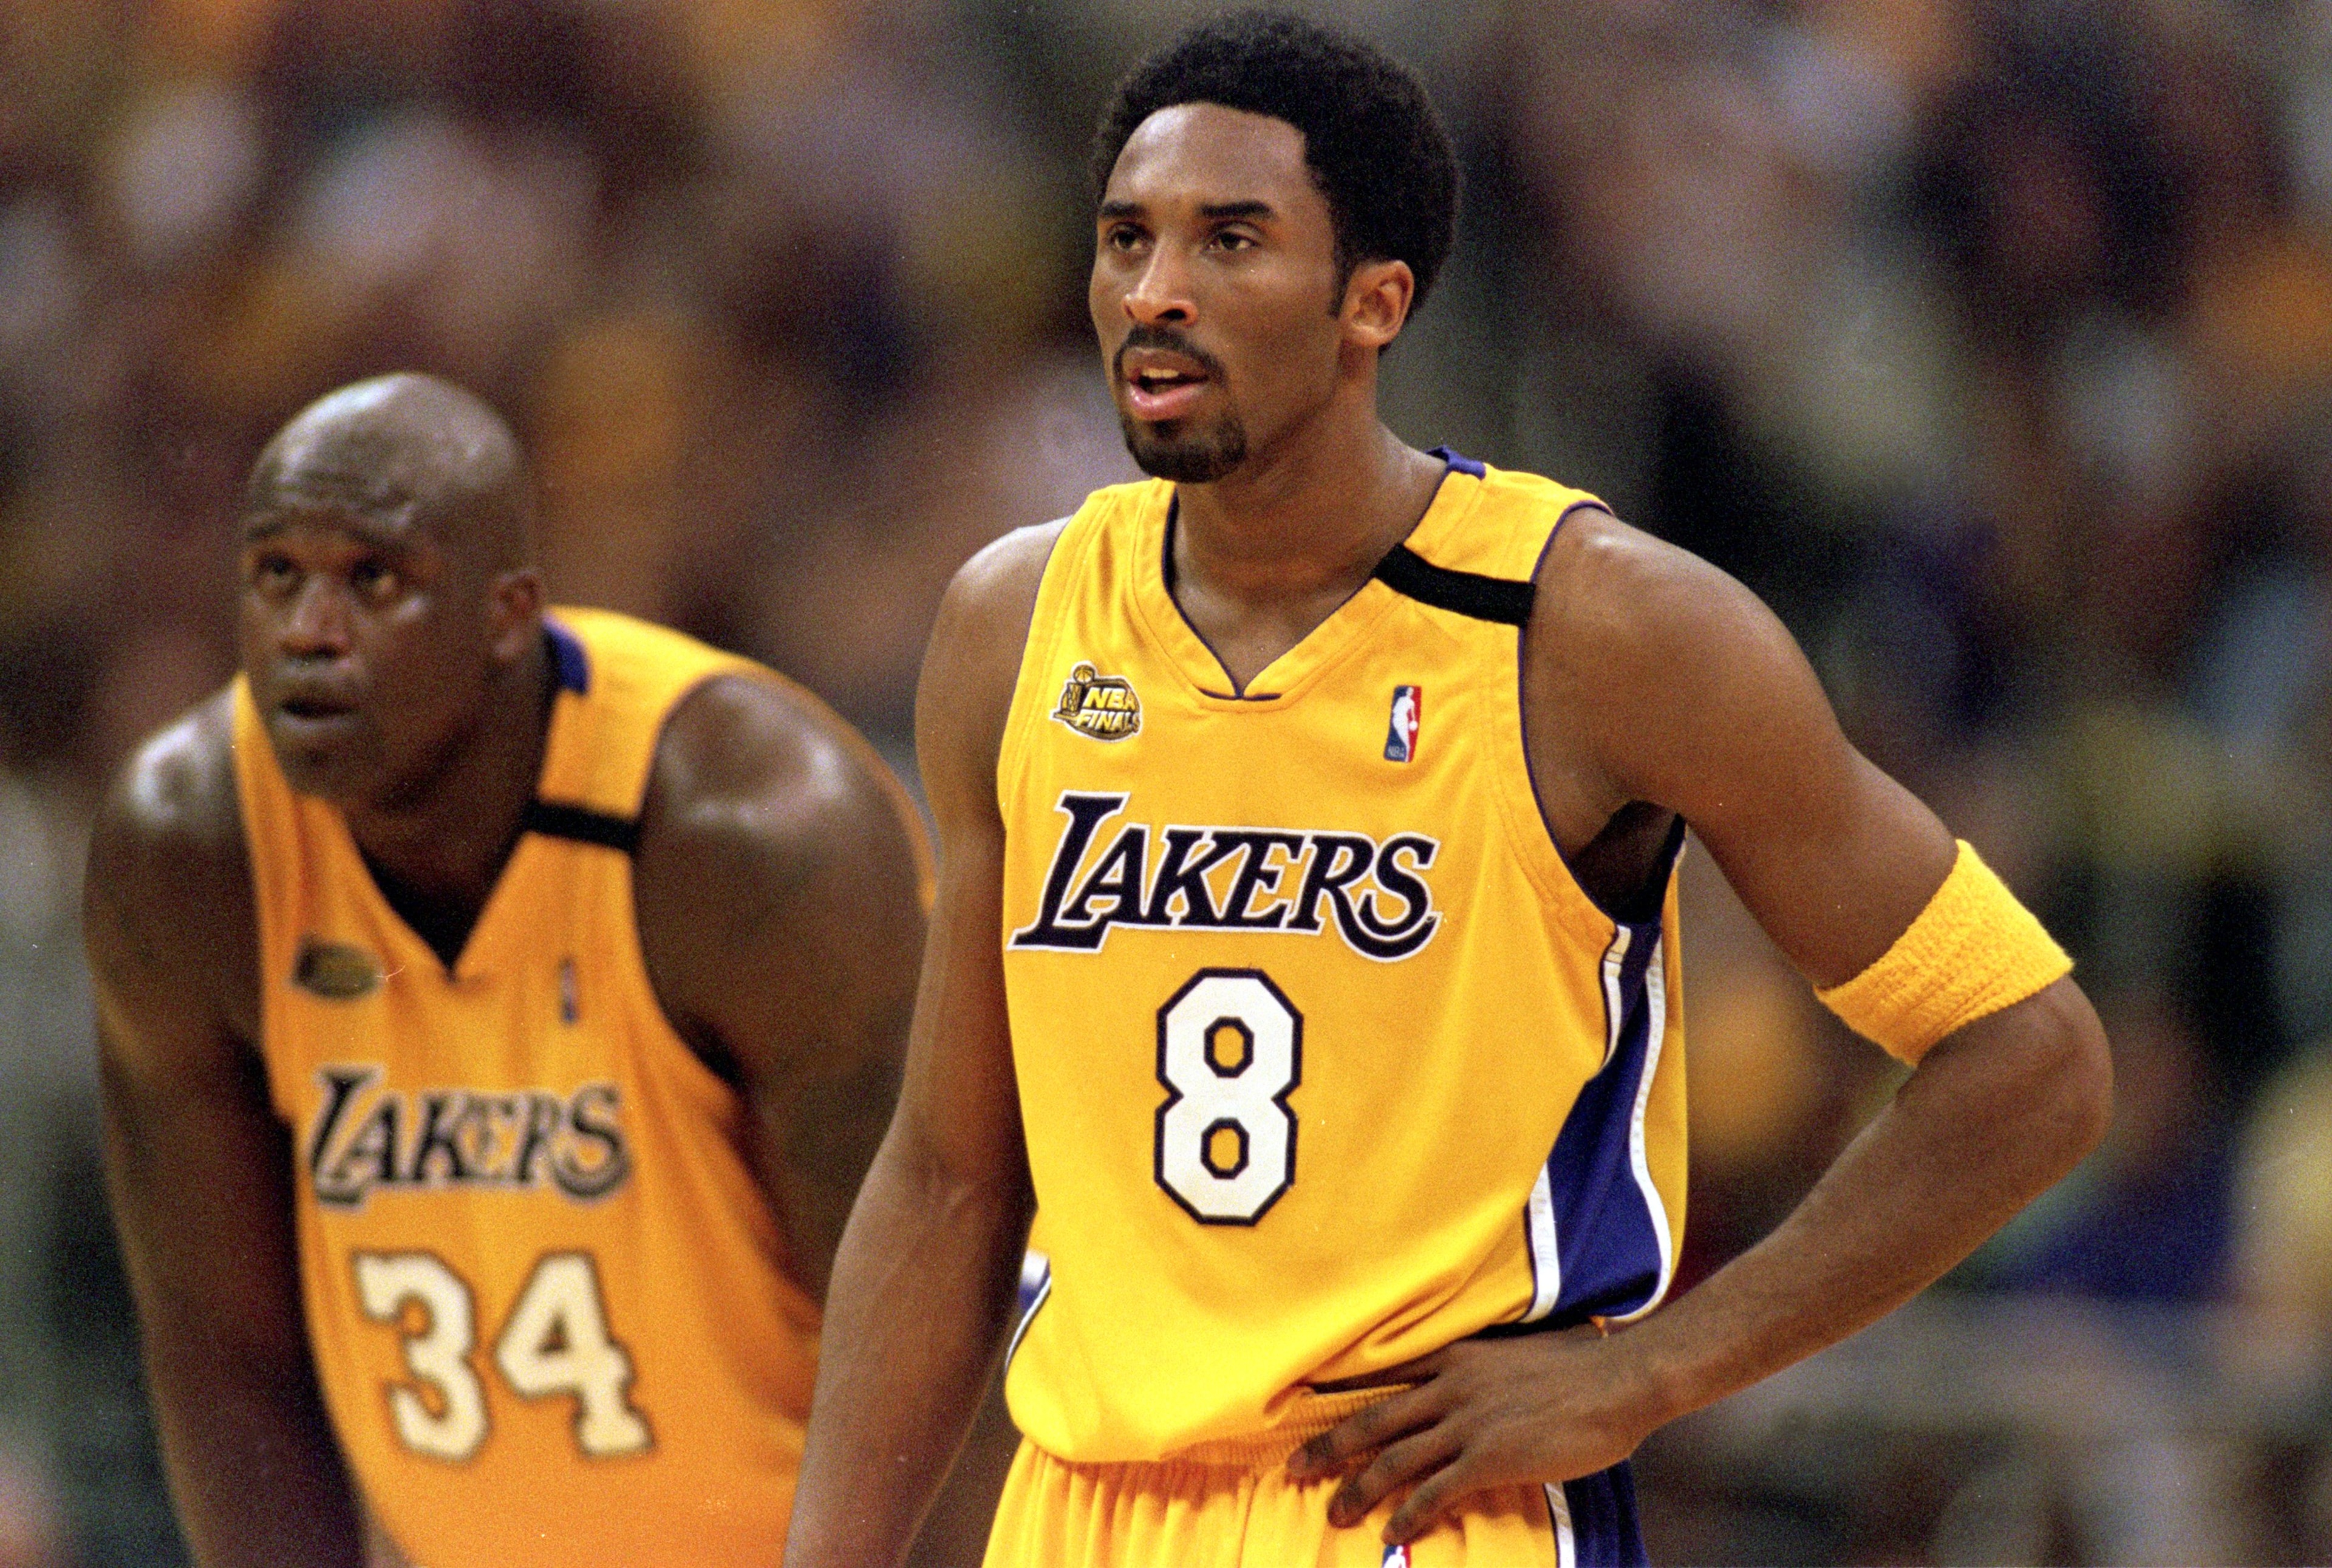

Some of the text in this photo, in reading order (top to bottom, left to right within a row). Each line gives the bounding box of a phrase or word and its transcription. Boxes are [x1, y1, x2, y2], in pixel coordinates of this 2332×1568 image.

[1082, 687, 1136, 710] NBA
[1006, 790, 1443, 963] LAKERS
[312, 1062, 633, 1205] LAKERS
[1153, 967, 1304, 1227] 8
[350, 1246, 657, 1465] 34
